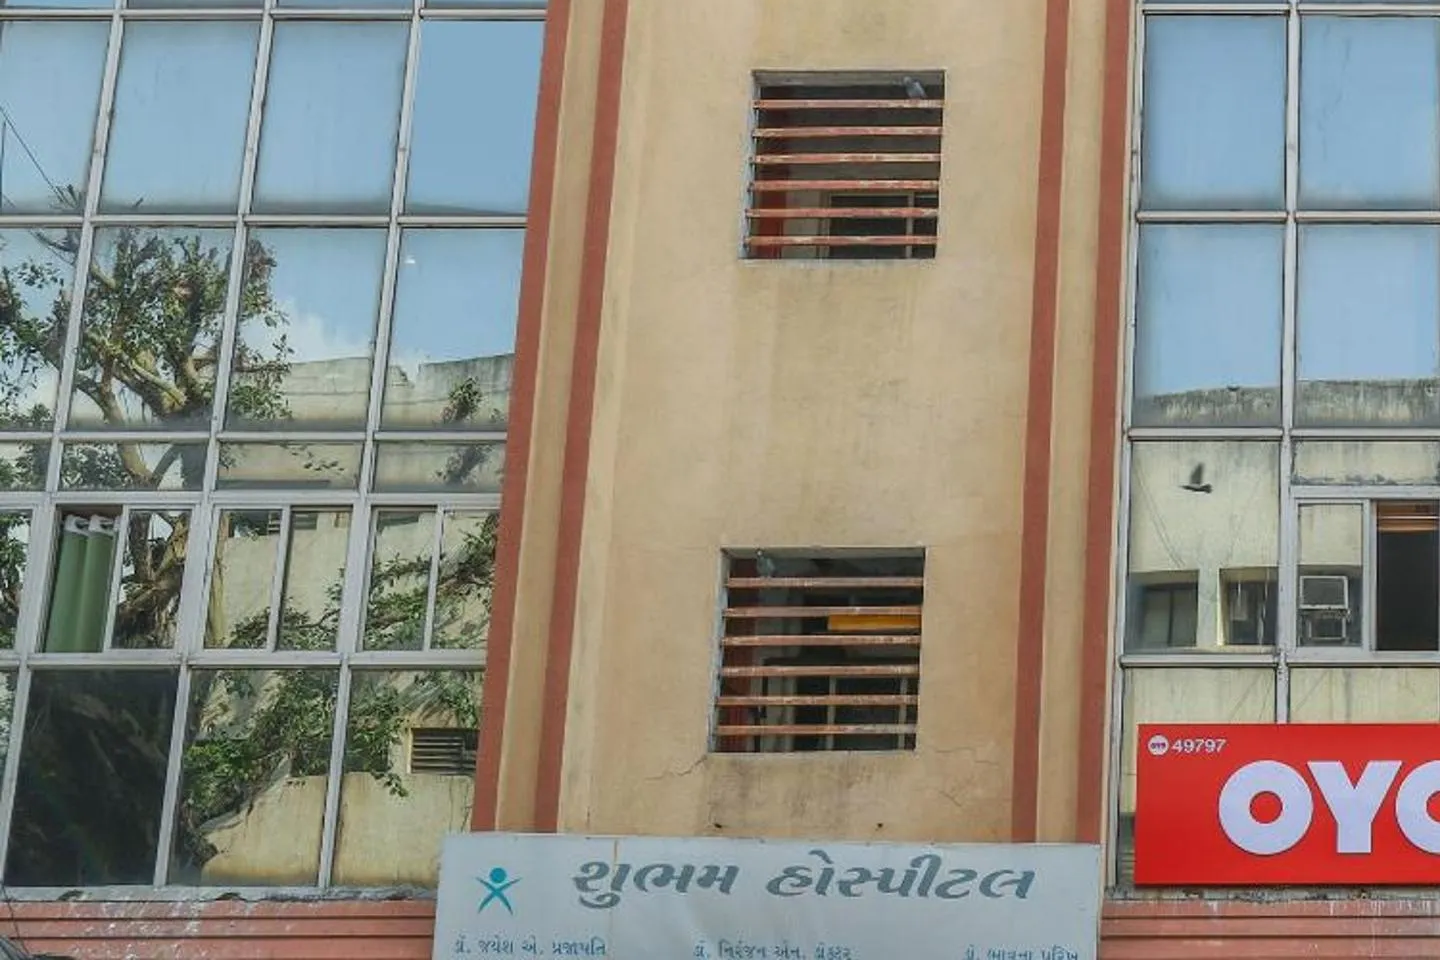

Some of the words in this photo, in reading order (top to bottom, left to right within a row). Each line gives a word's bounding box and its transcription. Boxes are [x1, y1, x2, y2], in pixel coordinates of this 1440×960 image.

[1171, 738, 1227, 753] 49797
[572, 861, 740, 909] શુભમ
[765, 849, 1036, 899] હોસ્પીટલ
